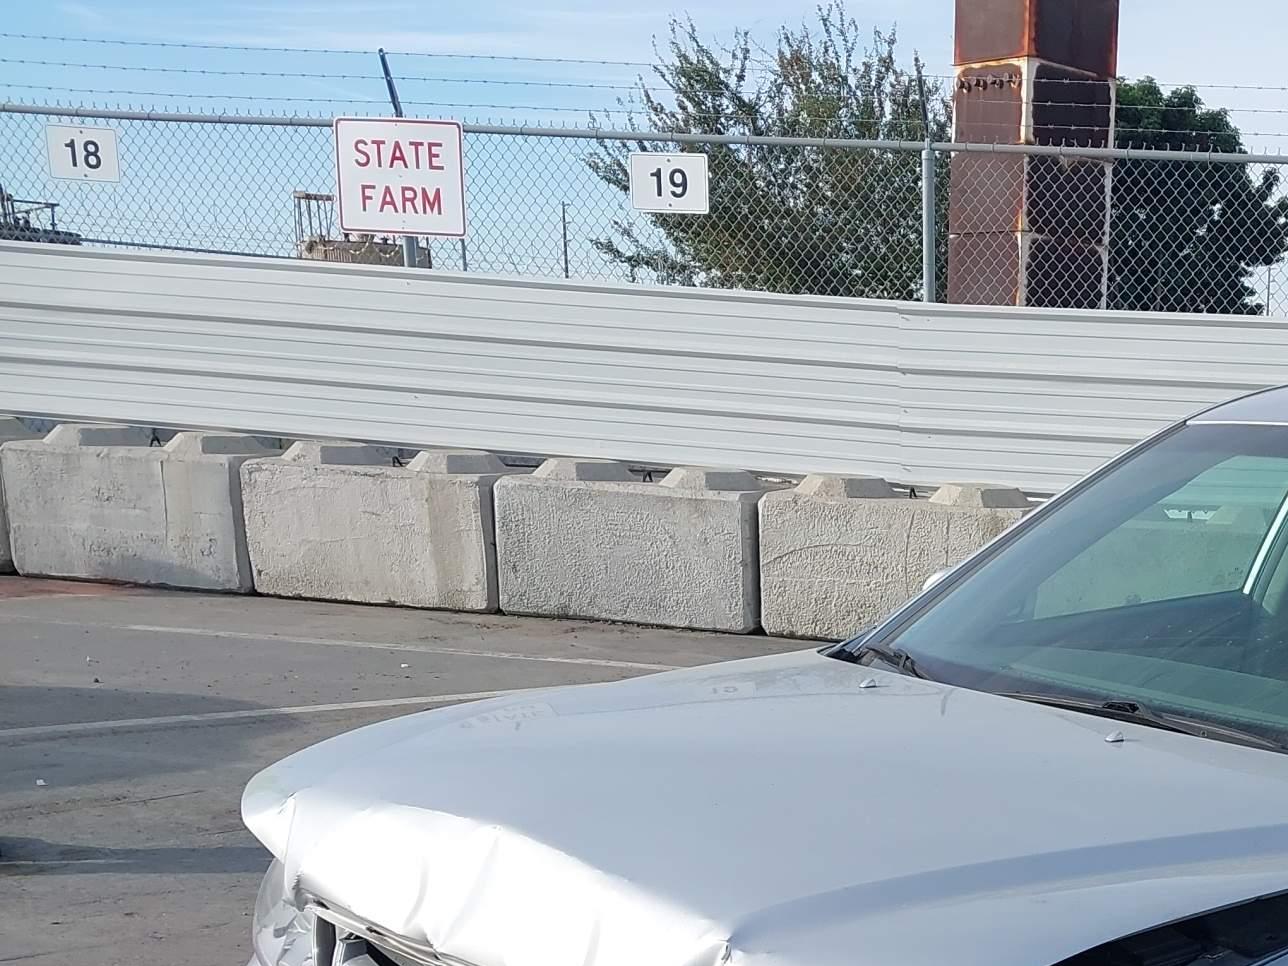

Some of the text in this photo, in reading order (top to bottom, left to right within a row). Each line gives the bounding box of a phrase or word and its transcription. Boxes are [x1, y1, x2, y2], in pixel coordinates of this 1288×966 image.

[64, 138, 102, 170] 18
[354, 139, 445, 171] STATE
[650, 167, 688, 199] 19
[360, 184, 442, 216] FARM
